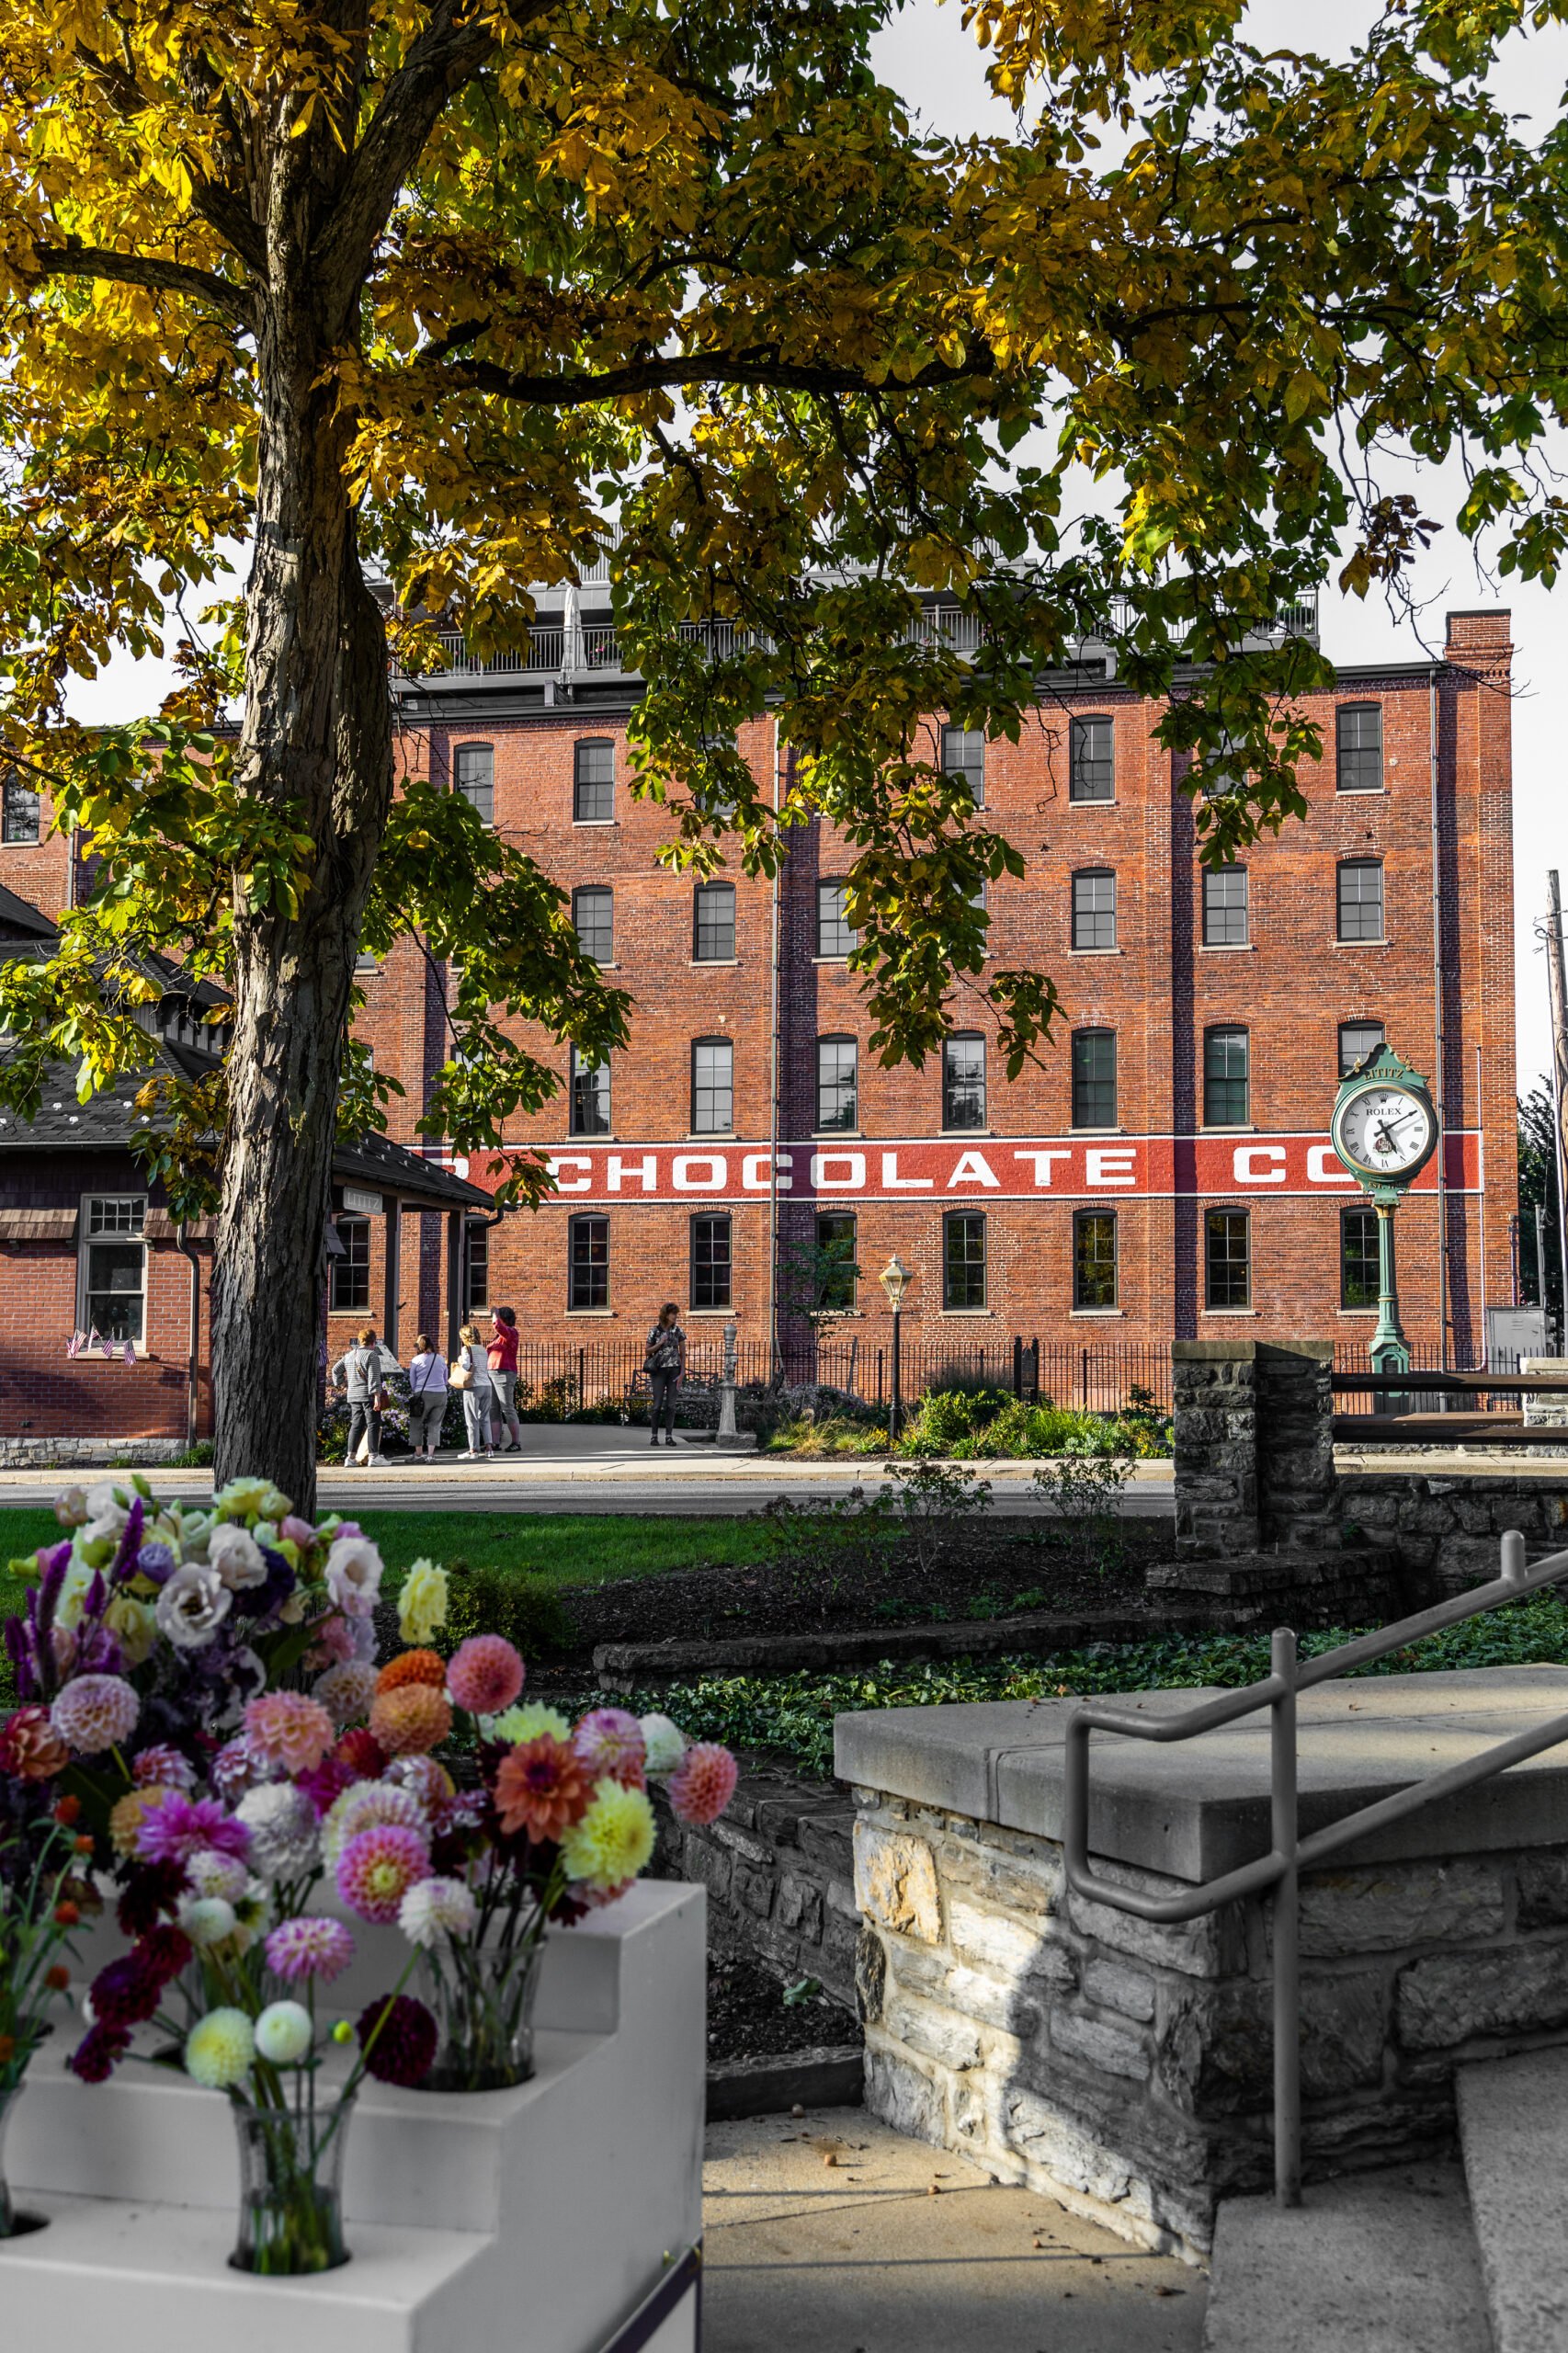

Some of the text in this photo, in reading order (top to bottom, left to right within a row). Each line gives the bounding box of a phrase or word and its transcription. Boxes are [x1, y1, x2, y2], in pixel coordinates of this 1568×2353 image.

[1364, 1068, 1403, 1080] LITITZ
[546, 1148, 1136, 1192] CHOCOLATE
[347, 1192, 380, 1210] LITITZ
